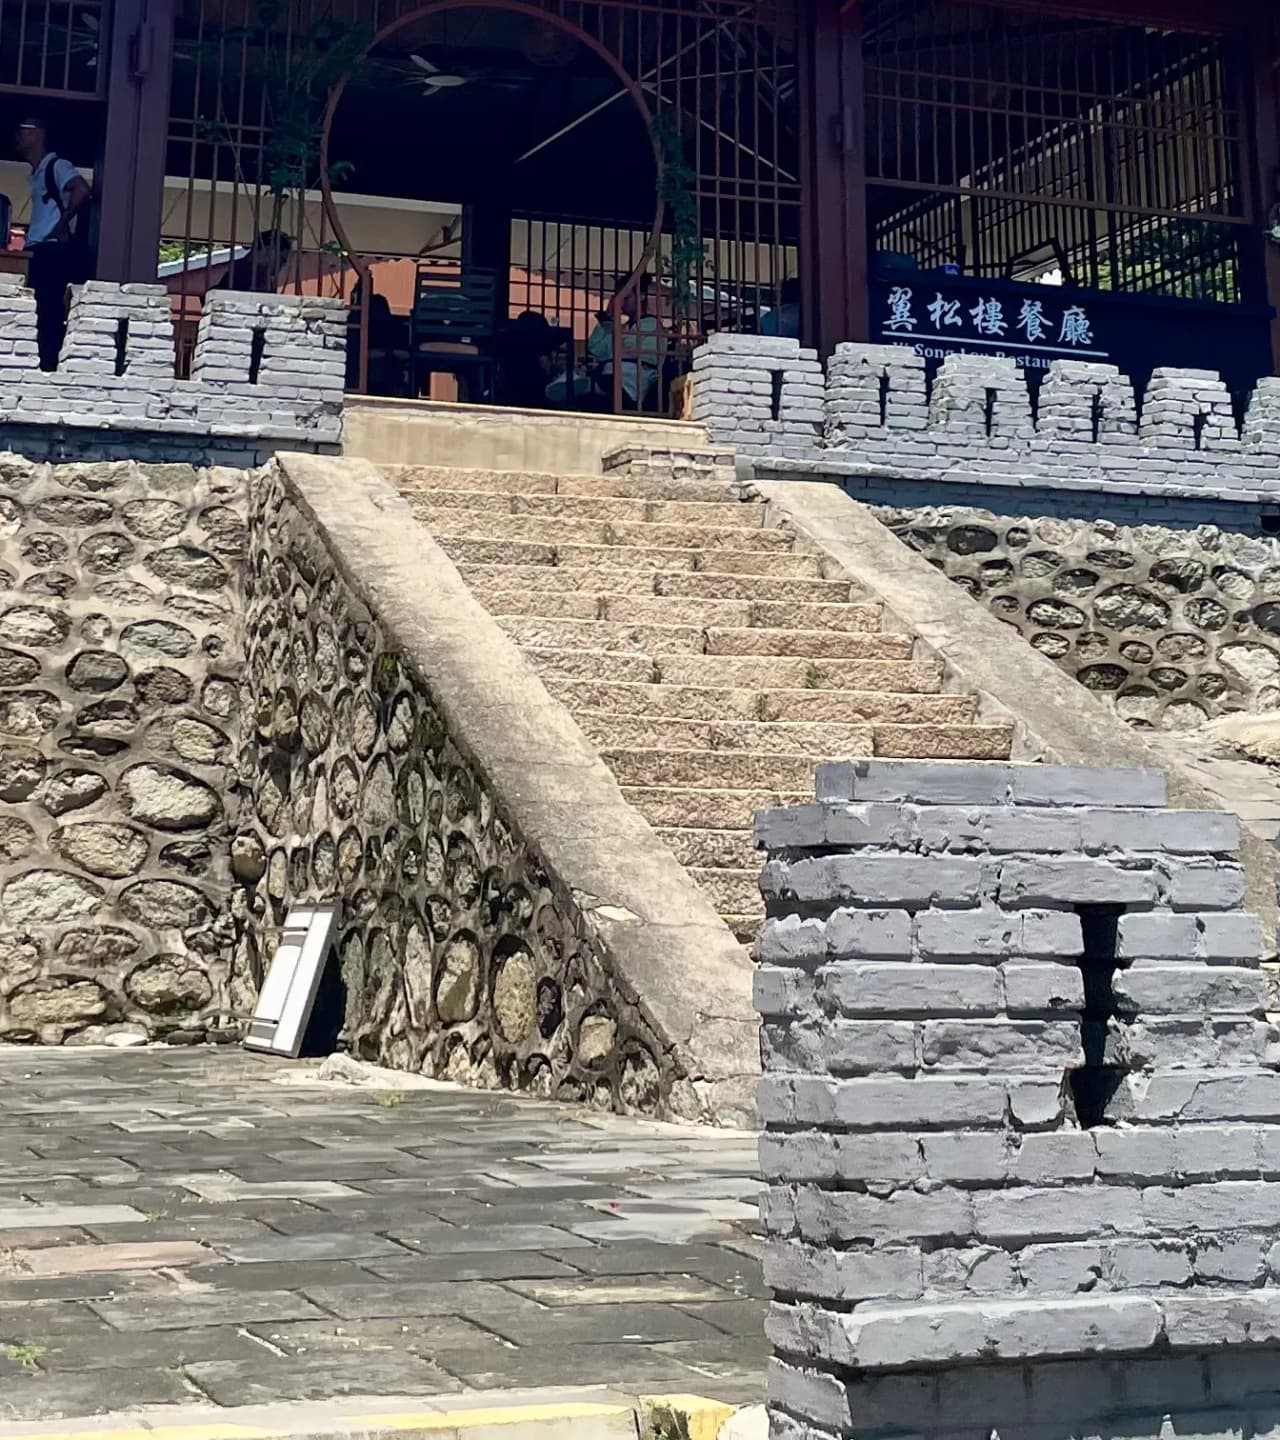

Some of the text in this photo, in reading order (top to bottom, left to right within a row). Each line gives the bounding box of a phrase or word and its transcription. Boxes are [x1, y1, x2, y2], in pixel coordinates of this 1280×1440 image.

[882, 286, 1095, 346] 翼松樓餐廳
